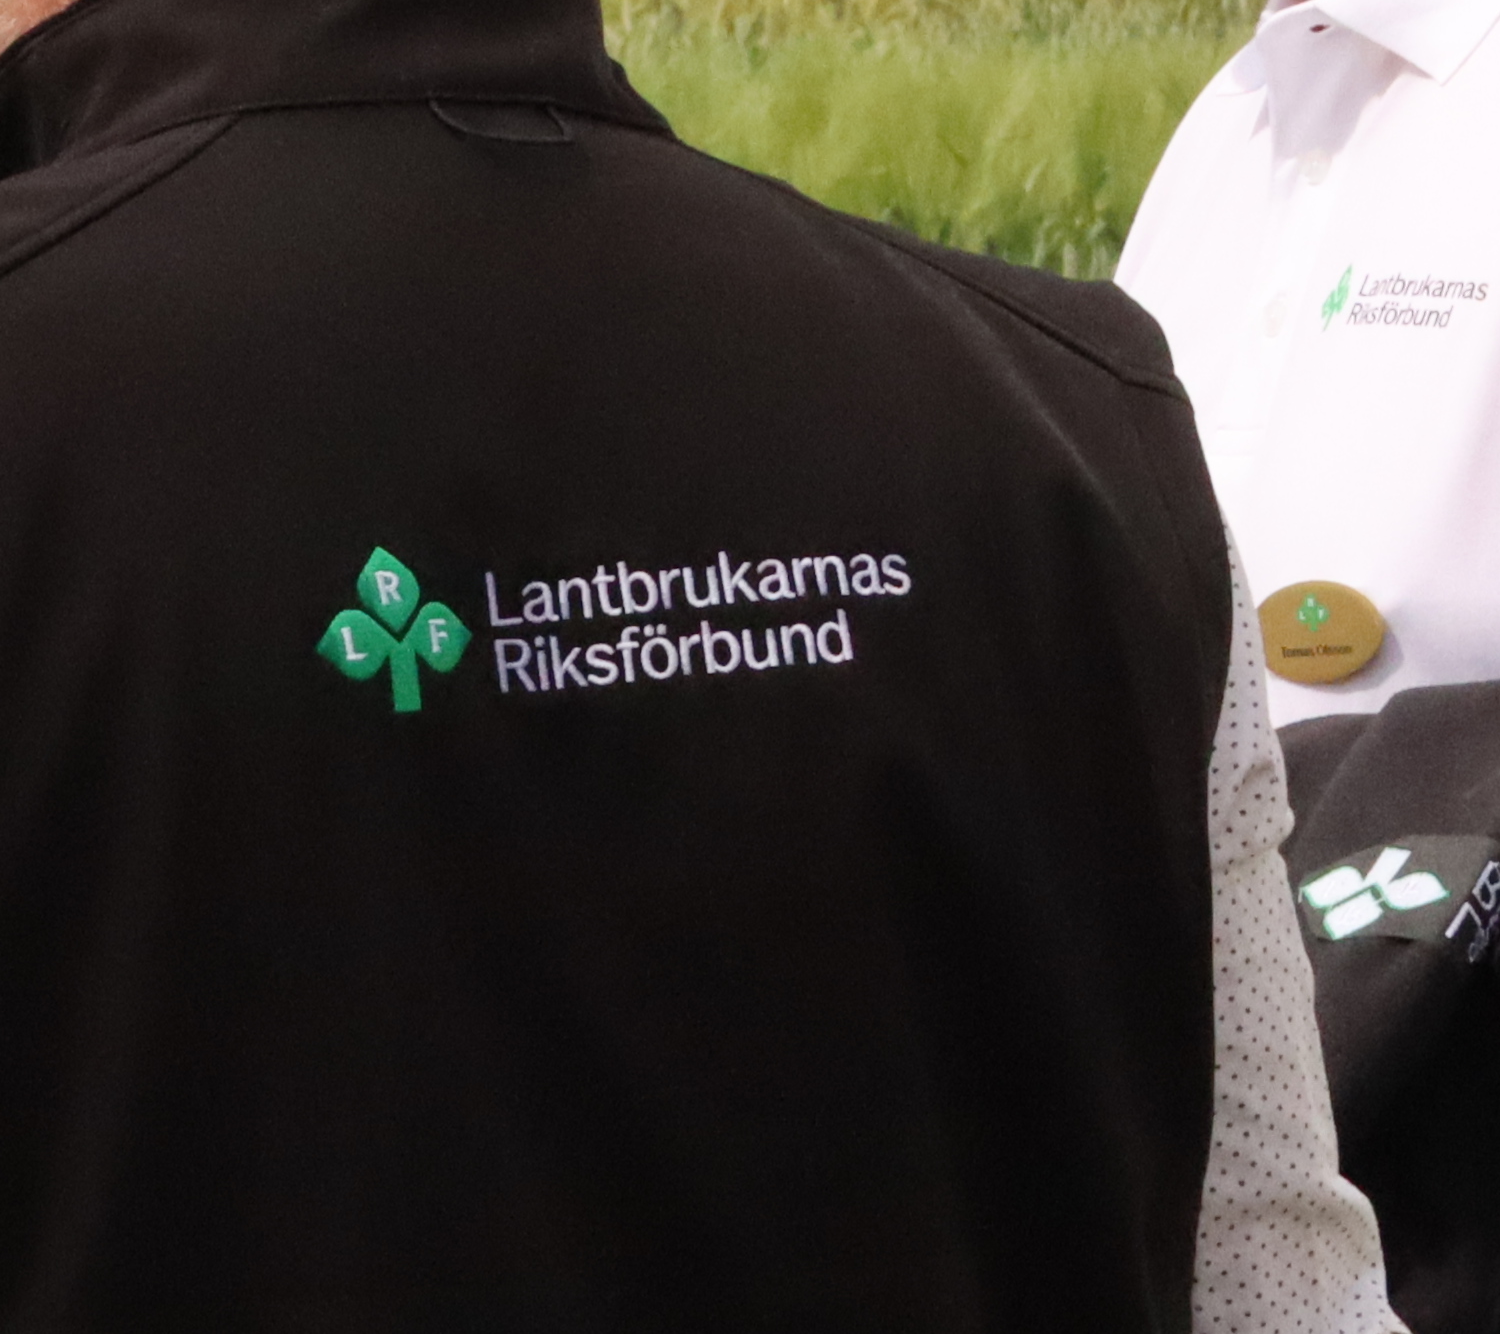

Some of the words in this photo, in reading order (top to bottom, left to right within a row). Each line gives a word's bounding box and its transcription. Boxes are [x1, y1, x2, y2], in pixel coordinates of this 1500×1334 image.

[1358, 273, 1489, 301] Lantbrukarnas
[485, 550, 912, 628] Lantbrukarnas
[494, 609, 854, 694] Riksförbund
